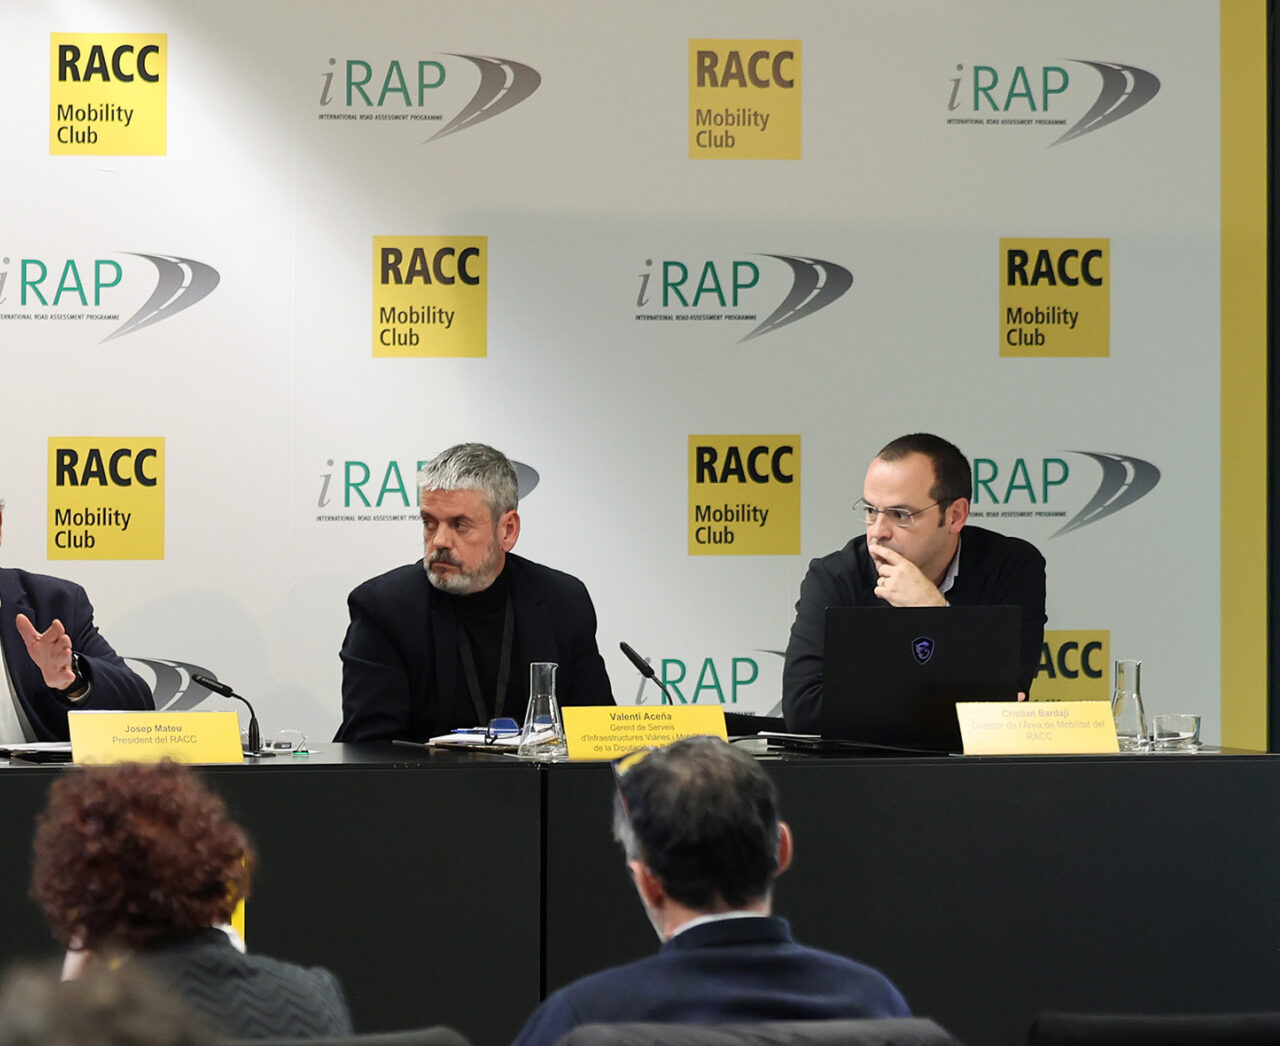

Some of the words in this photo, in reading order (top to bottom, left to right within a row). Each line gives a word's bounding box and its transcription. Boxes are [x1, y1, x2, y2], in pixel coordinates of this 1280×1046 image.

[59, 45, 159, 83] RACC
[698, 51, 793, 88] RACC
[320, 58, 445, 106] iRAP
[948, 64, 1069, 111] iRAP
[58, 104, 133, 126] Mobility
[697, 109, 769, 131] Mobility
[57, 126, 97, 143] Club
[697, 131, 734, 147] Club
[381, 246, 480, 286] RACC
[1008, 249, 1102, 286] RACC
[637, 259, 759, 307] iRAP
[381, 306, 454, 328] Mobility
[1007, 306, 1078, 329] Mobility
[380, 328, 419, 346] Club
[1007, 328, 1045, 346] Club
[56, 448, 157, 487] RACC
[696, 446, 793, 484] RACC
[973, 458, 1069, 504] RAP
[55, 508, 131, 531] Mobility
[696, 504, 768, 527] Mobility
[55, 530, 95, 548] Club
[696, 526, 734, 544] Club
[1034, 641, 1102, 679] ACC
[1002, 709, 1035, 718] Cristian
[1093, 720, 1105, 728] del
[125, 725, 152, 733] Josep
[155, 724, 182, 732] Mateu
[648, 723, 675, 731] Serveis
[112, 736, 152, 744] President
[170, 735, 197, 743] RACC
